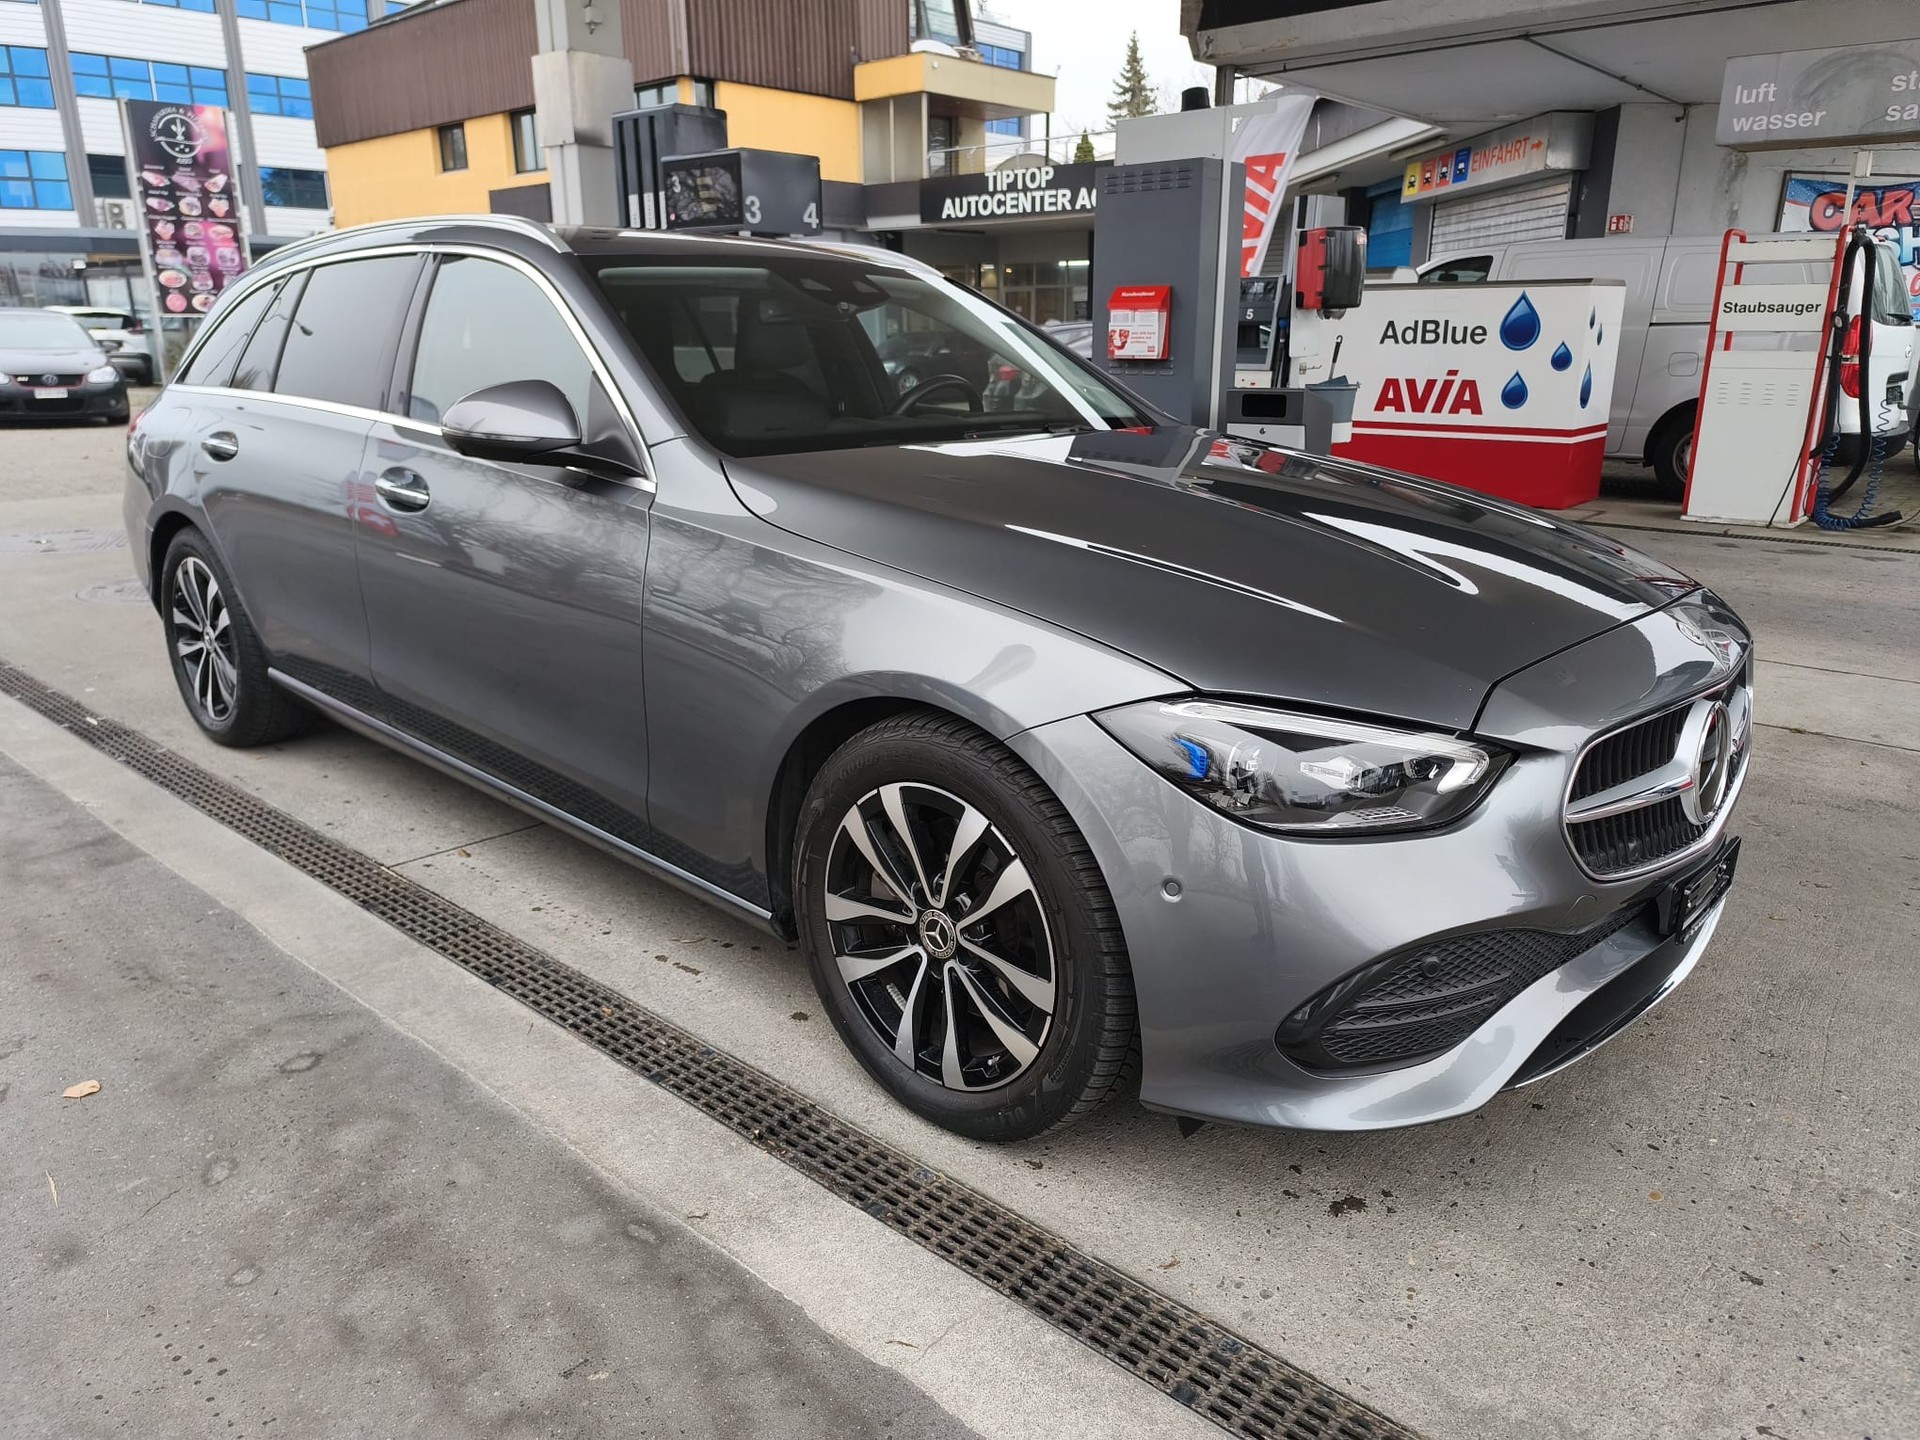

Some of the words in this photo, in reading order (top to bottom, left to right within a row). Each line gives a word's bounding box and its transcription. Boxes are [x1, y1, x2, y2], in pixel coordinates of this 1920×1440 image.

[1734, 82, 1777, 105] luft
[1890, 70, 1920, 92] st
[1732, 109, 1827, 132] wasser
[1884, 103, 1920, 122] sa
[1471, 136, 1531, 173] EINFAHRT
[671, 175, 681, 193] 3
[985, 166, 1055, 192] TIPTOP
[744, 195, 762, 224] 3
[803, 202, 820, 229] 4
[941, 187, 1072, 220] AUTOCENTER
[1809, 188, 1915, 232] CAR
[1873, 226, 1920, 266] SH
[1245, 309, 1254, 320] 5
[1723, 301, 1822, 316] Staubsauger
[1379, 319, 1488, 345] AdBlue
[1373, 369, 1483, 416] AVIA
